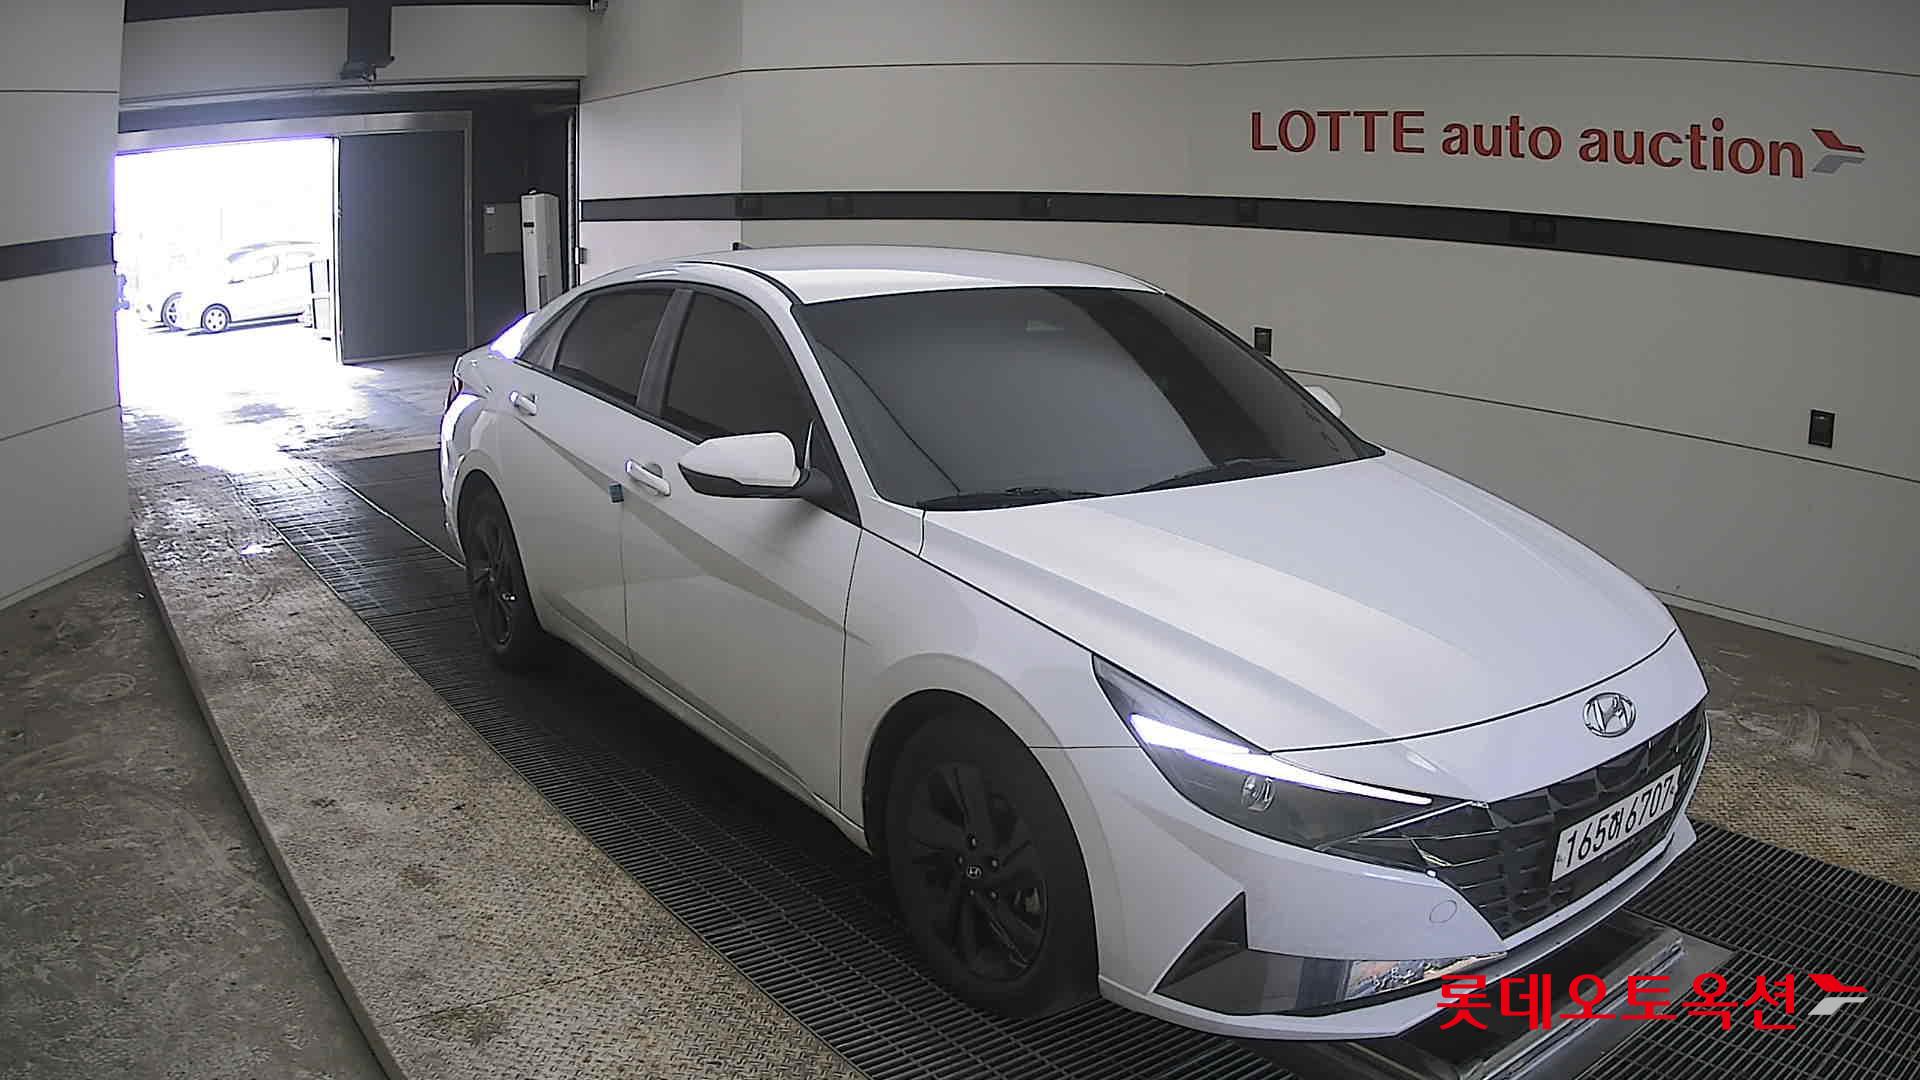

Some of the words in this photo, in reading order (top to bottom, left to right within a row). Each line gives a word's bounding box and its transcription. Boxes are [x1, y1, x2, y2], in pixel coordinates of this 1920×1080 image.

[1251, 110, 1425, 154] LOTTE
[1441, 115, 1562, 161] auto
[1578, 117, 1804, 179] auction
